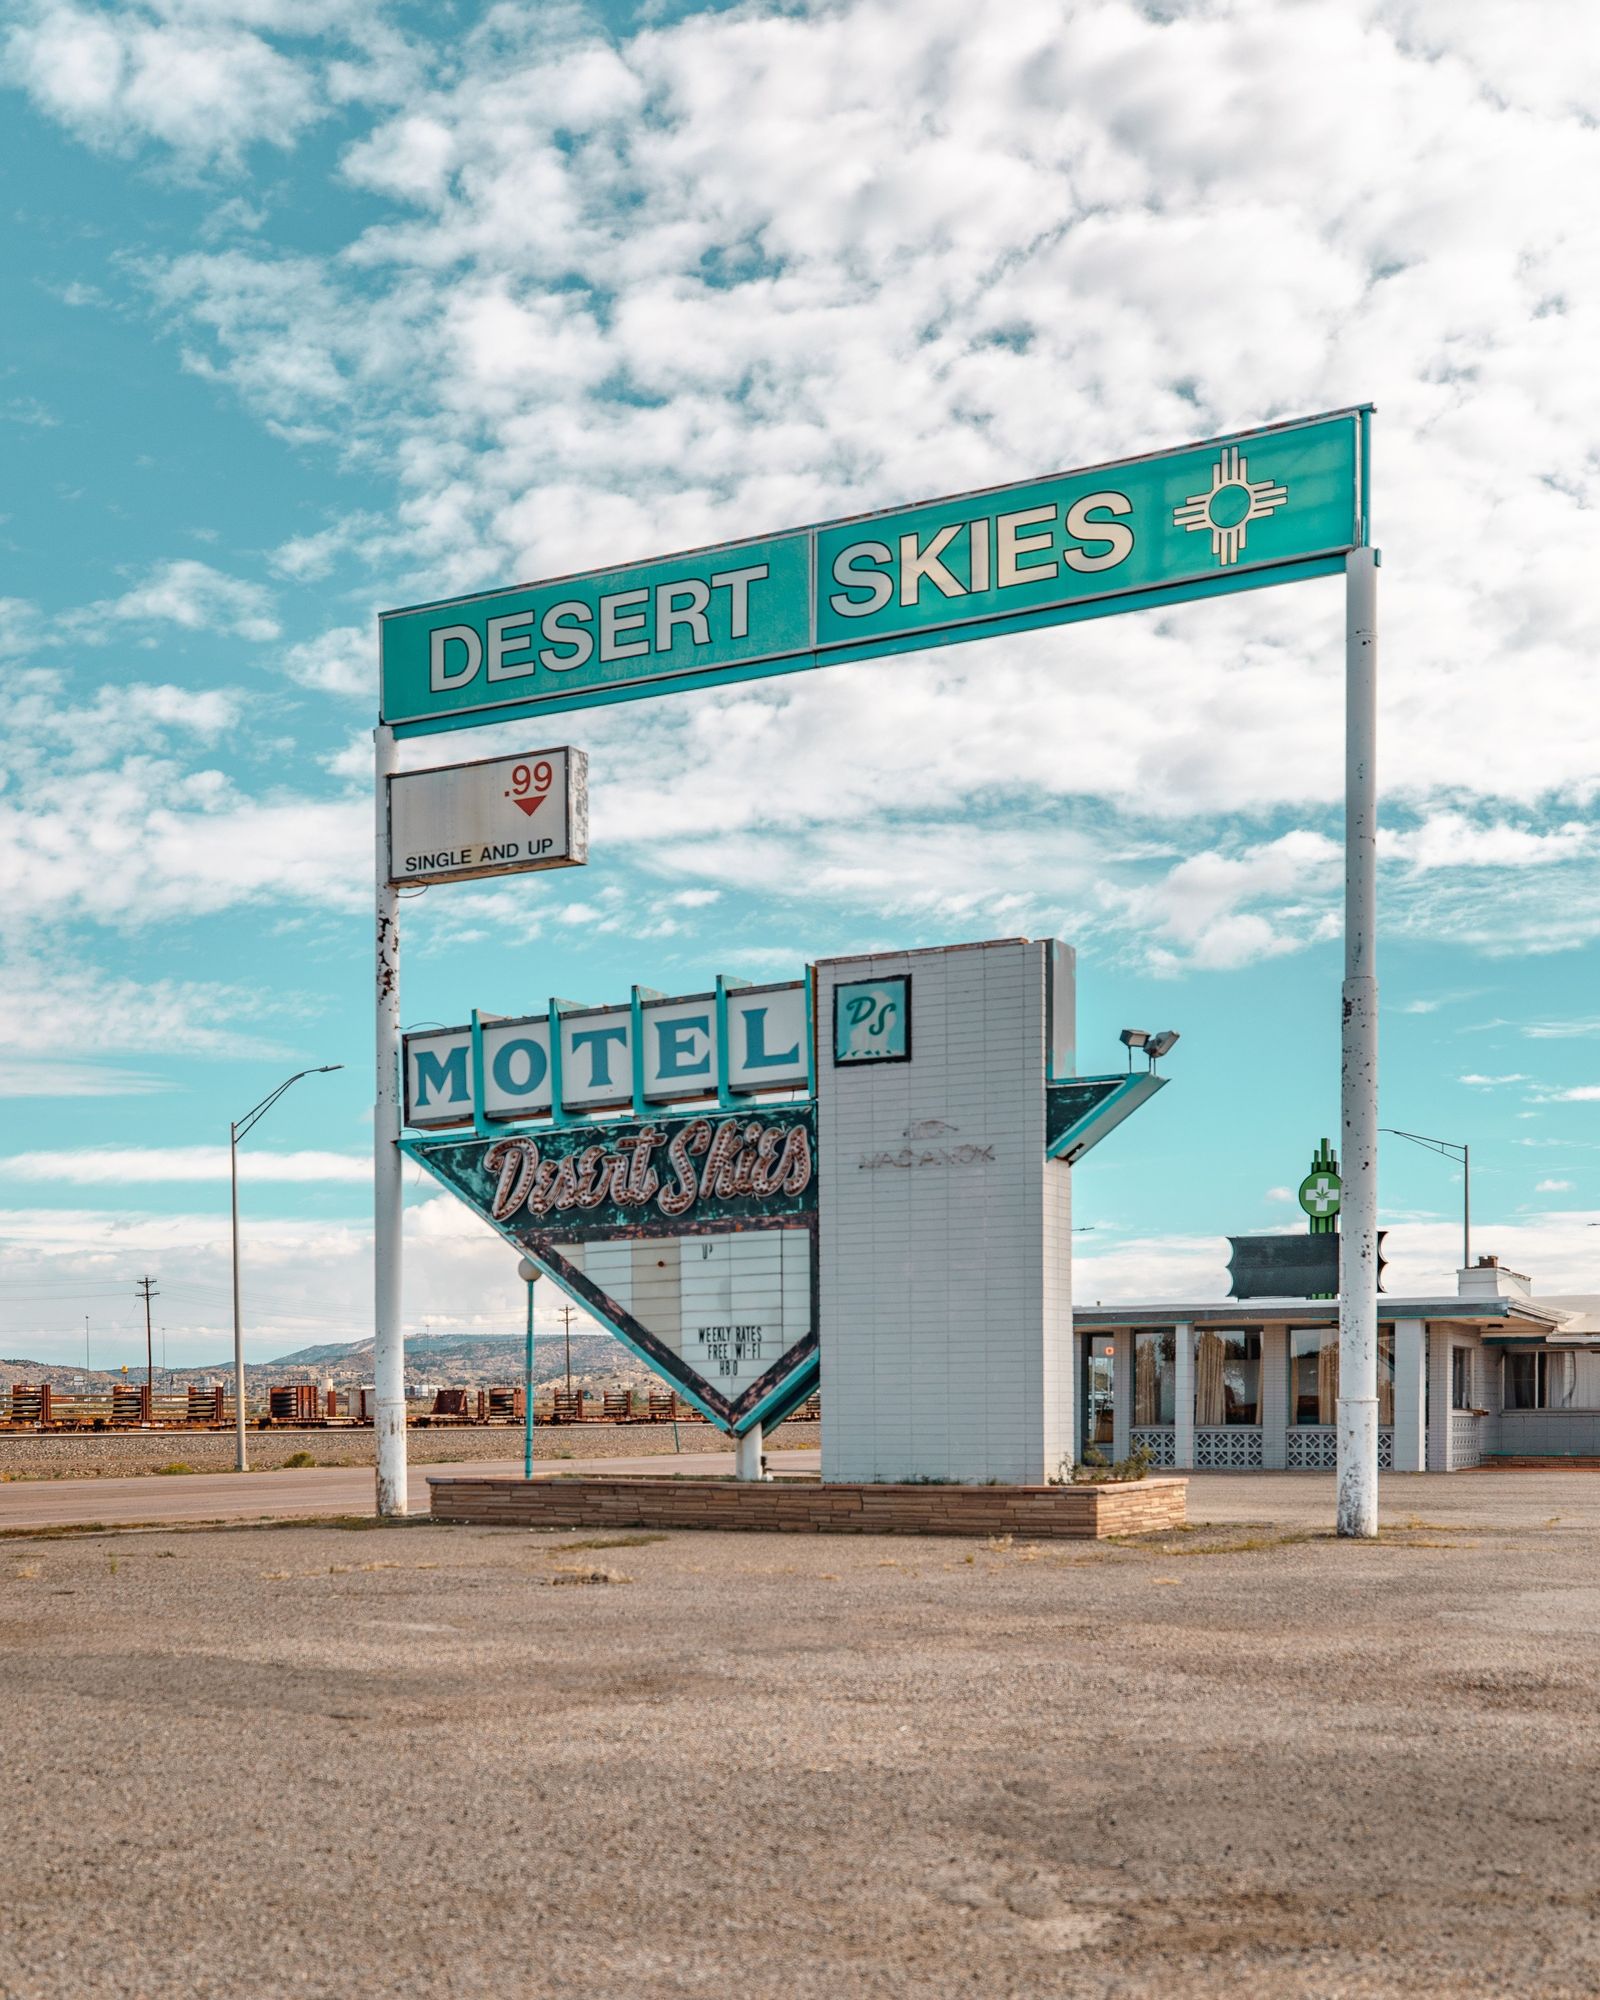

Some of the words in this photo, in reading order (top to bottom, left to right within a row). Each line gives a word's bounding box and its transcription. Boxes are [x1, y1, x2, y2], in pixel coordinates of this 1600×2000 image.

[428, 563, 770, 693] DESERT
[830, 489, 1135, 619] SKIES
[504, 761, 553, 797] .99
[405, 849, 472, 872] SINGLE
[480, 843, 519, 862] AND
[528, 838, 553, 856] UP
[413, 1007, 800, 1108] MOTEL
[483, 1125, 668, 1221] Desert
[657, 1118, 812, 1217] Skies
[698, 1327, 732, 1343] WEEKLY
[736, 1326, 762, 1342] RATES
[708, 1344, 728, 1360] FREE
[735, 1343, 761, 1359] WI-FI
[719, 1360, 738, 1376] HBO
